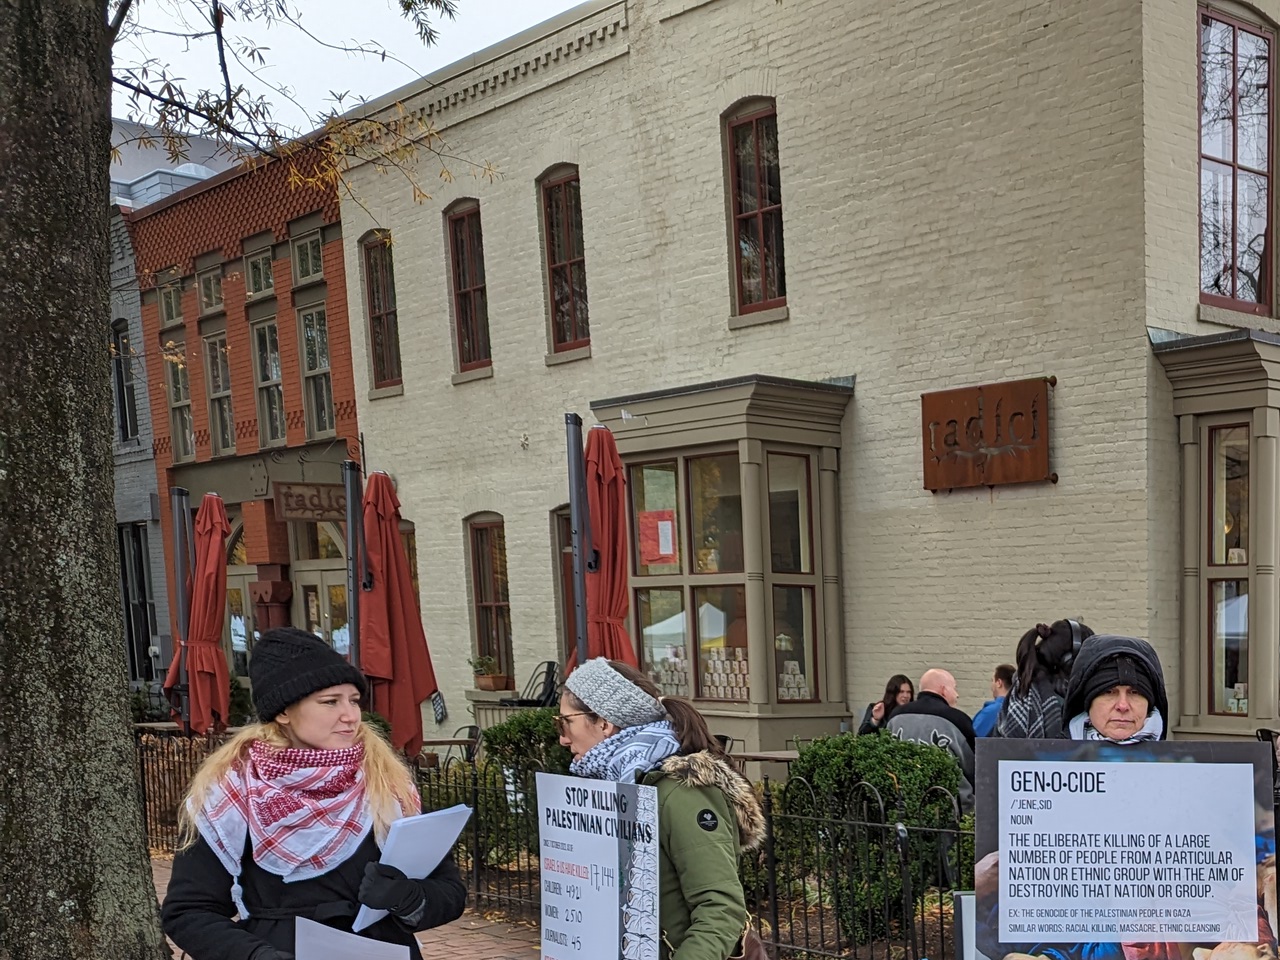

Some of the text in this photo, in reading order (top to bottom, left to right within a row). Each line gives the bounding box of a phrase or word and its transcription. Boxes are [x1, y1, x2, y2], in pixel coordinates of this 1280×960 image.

[565, 786, 627, 813] STOP KILLING
[546, 807, 653, 843] PALESTINIAN CIVILIANS
[1010, 814, 1033, 825] NOUN
[1009, 833, 1210, 848] THE DELIBERATE KILLING OF A LARGE
[1009, 850, 1233, 865] NUMBER OF PEOPLE FROM A PARTICULAR
[1009, 867, 1245, 881] NATION OR ETHNIC GROUP WITH THE AIM OF
[1009, 884, 1214, 898] DESTROYING THAT NATION OR GROUP.
[565, 909, 582, 923] 2510
[1008, 909, 1191, 918] EX: THE GENOCIDE OF THE PALESTINIAN PEOPLE IN GAZA
[1008, 924, 1220, 933] SIMILAR WORDS: RACIAL KILLING, MASSACRE, ETHNIC CLEANSING
[571, 936, 582, 950] 45
